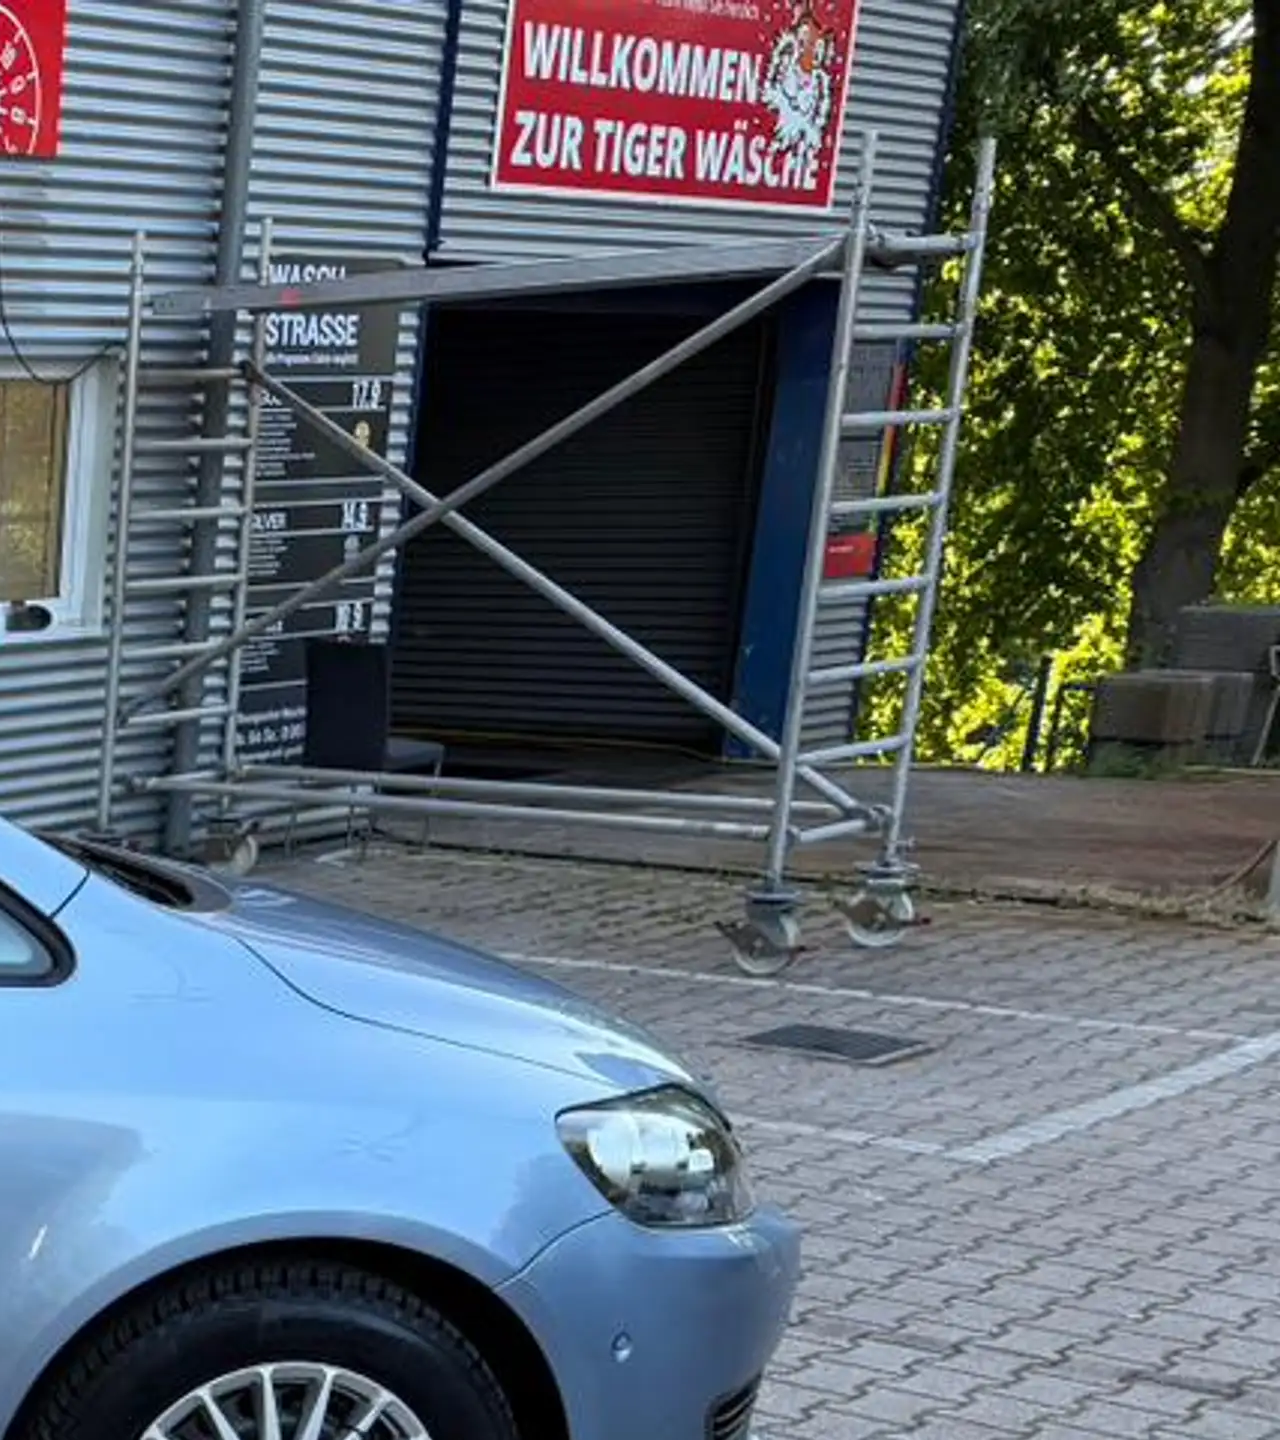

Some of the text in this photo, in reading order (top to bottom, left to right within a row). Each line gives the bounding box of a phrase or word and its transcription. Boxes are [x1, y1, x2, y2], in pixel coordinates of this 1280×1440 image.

[524, 21, 763, 104] WILLKOMMEN
[510, 110, 819, 190] ZUR TIGER WÄSCHE
[265, 312, 359, 347] STRASSE
